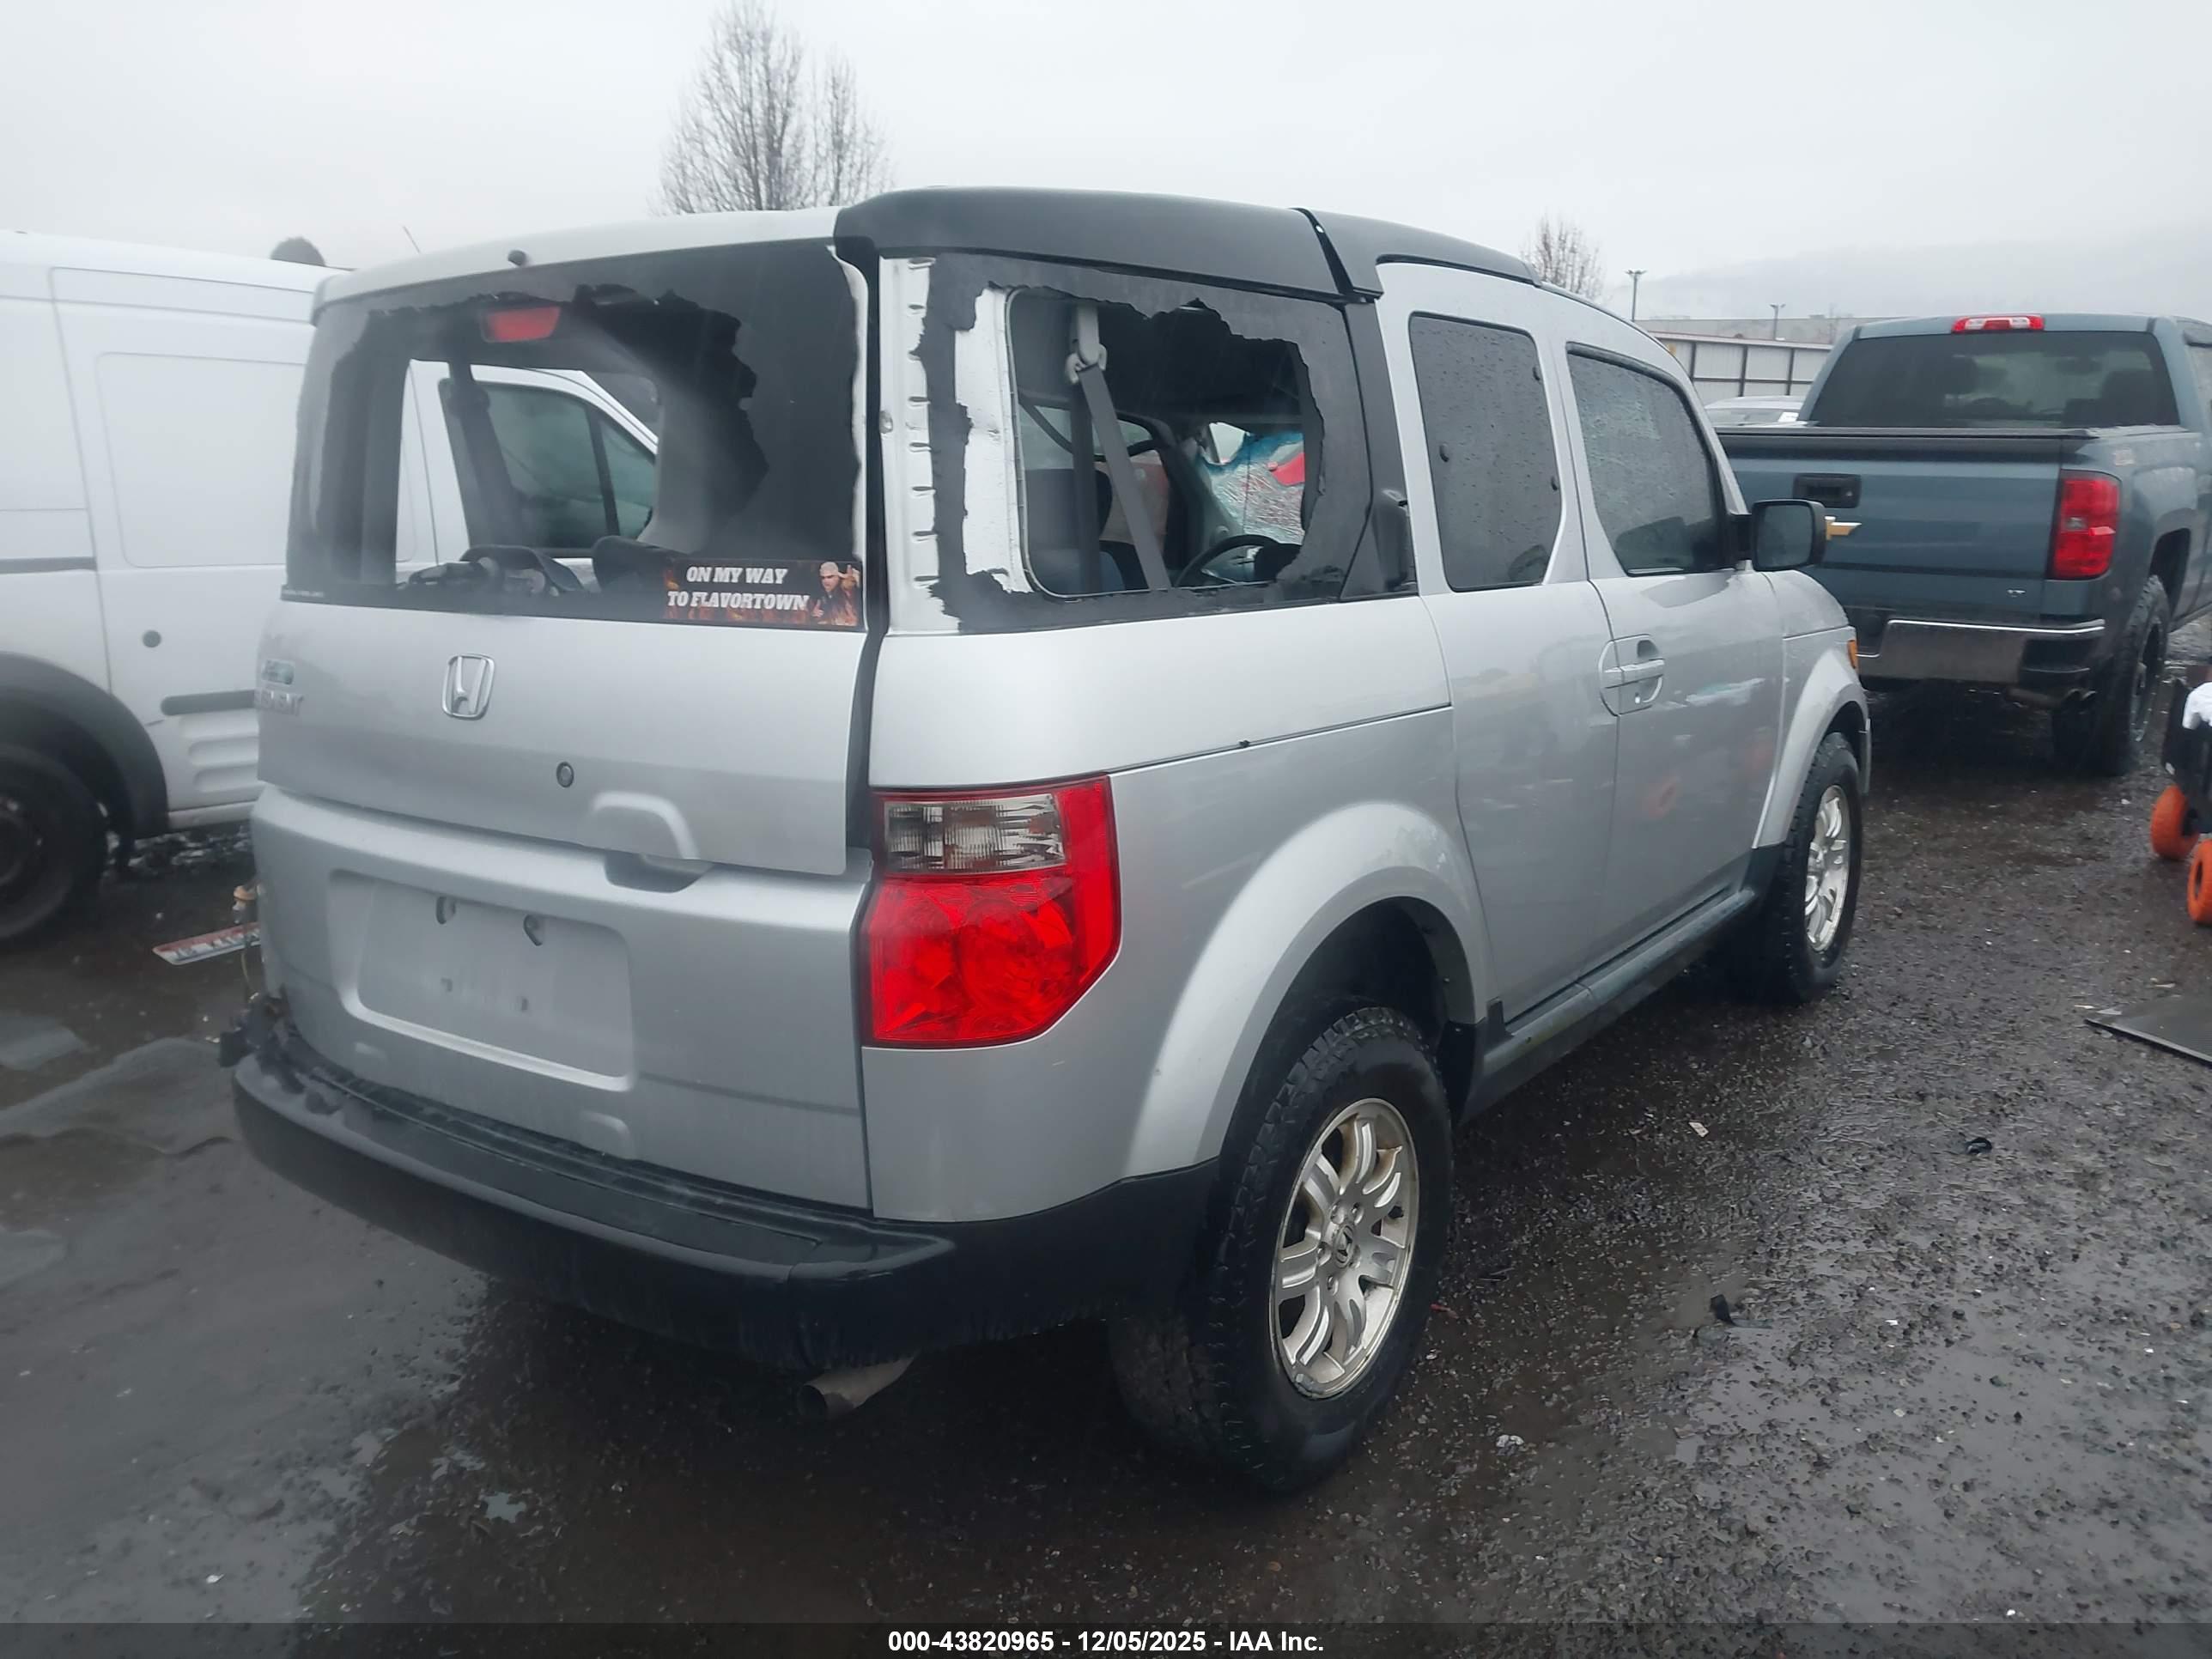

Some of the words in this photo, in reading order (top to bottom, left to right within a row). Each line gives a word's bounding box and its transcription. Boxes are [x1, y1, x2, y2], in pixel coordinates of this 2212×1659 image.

[686, 566, 713, 582] ON
[713, 567, 744, 583] MY
[745, 568, 789, 585] WAY
[667, 590, 689, 607] TO
[690, 592, 811, 611] FLAVORTOWN
